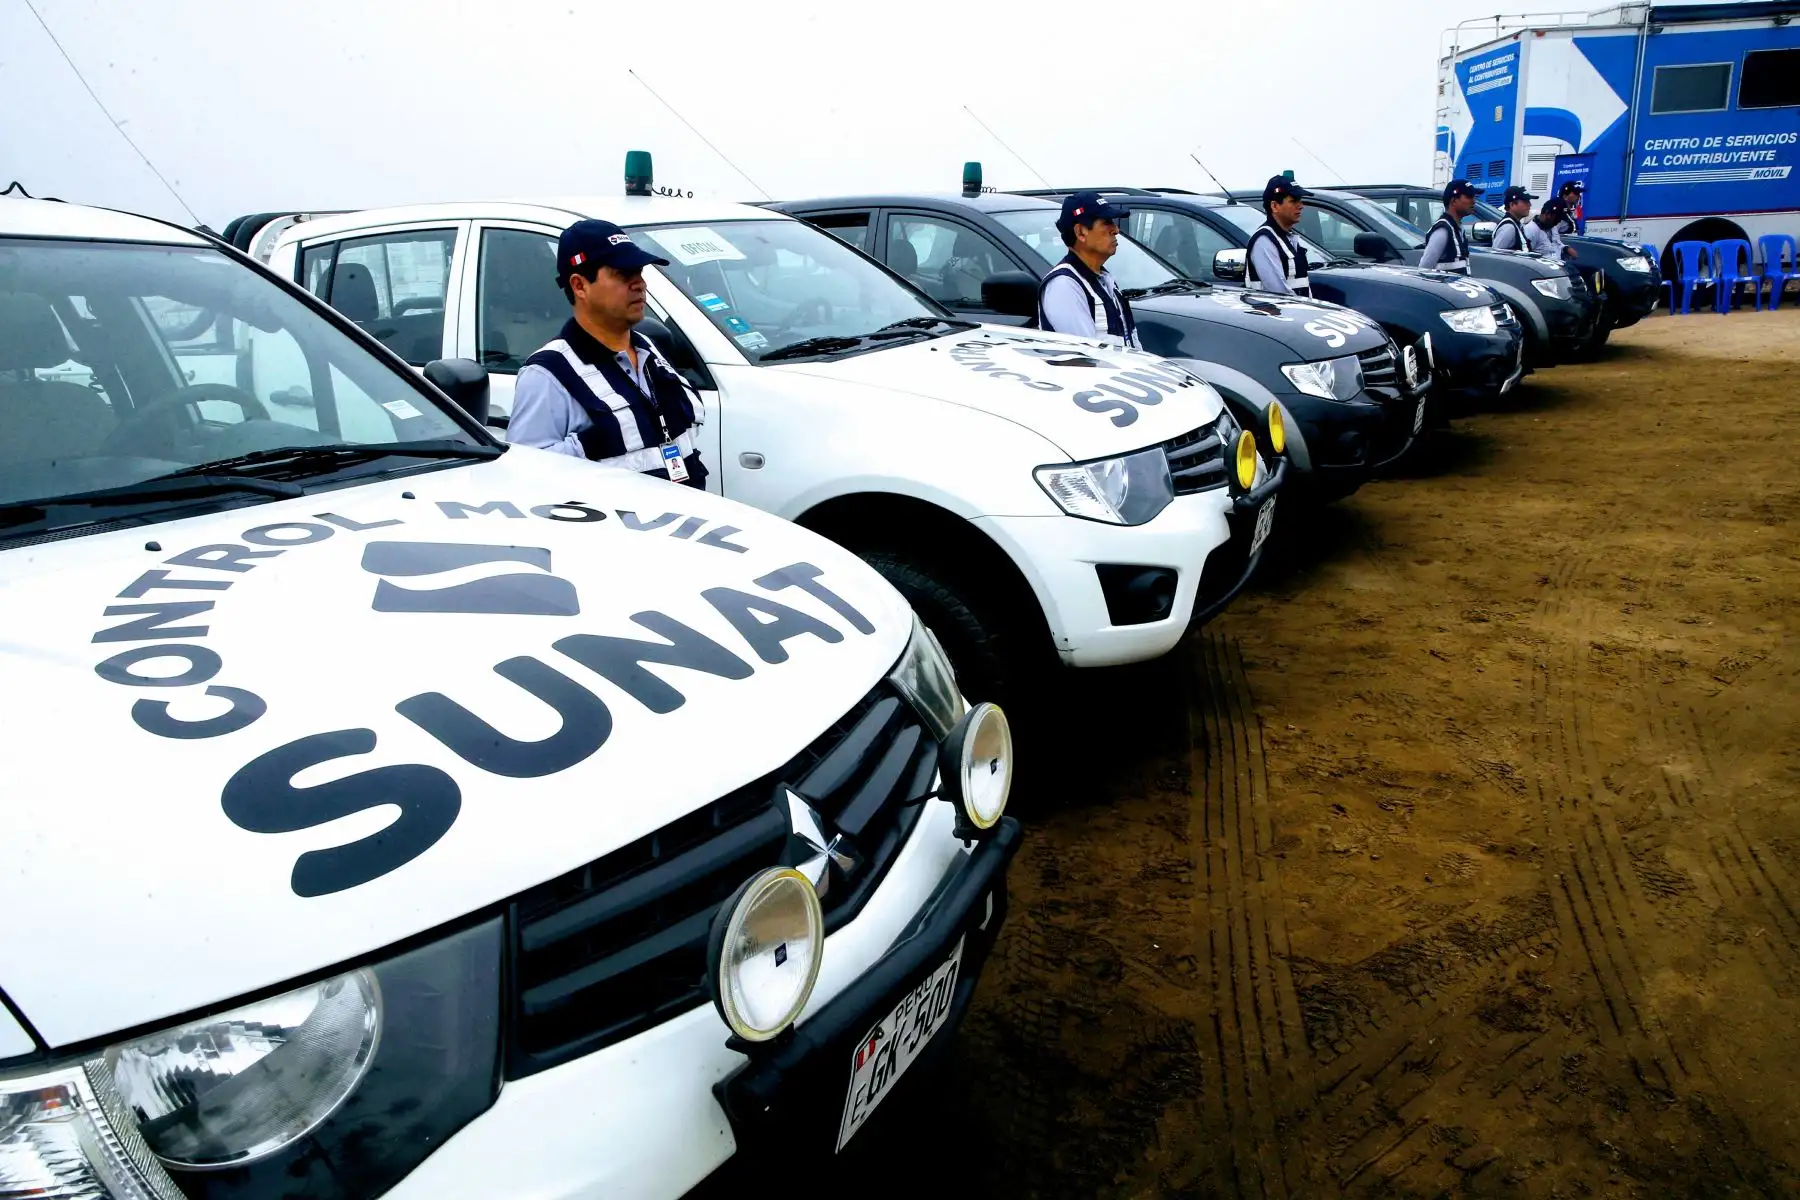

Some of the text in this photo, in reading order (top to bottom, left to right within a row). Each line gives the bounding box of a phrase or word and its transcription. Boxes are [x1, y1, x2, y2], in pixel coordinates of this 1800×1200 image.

[1641, 150, 1777, 167] AL CONTRIBUYENTE
[1644, 132, 1798, 151] CENTRO DE SERVICIOS
[1753, 168, 1785, 178] MÓVIL
[436, 500, 749, 554] MÓVIL
[92, 512, 405, 740] CONTROL
[221, 562, 876, 898] SUNAT
